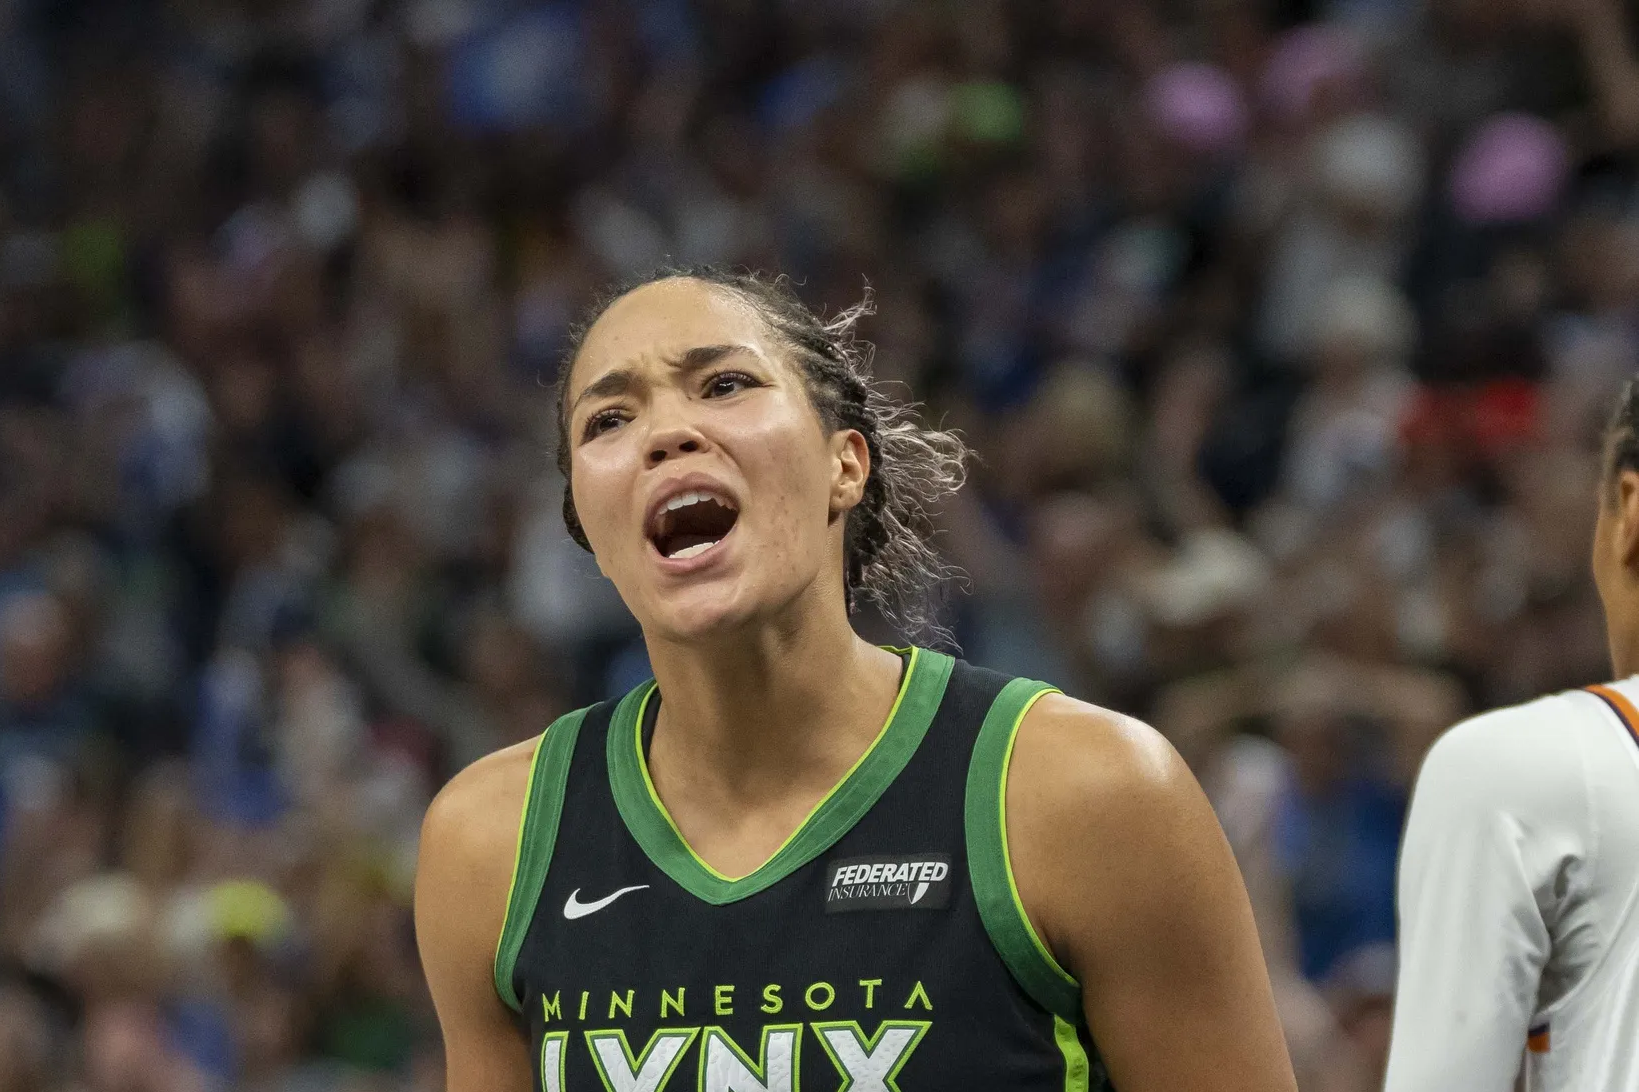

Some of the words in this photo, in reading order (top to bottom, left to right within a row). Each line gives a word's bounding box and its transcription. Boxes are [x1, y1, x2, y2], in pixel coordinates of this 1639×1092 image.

[832, 862, 949, 887] FEDERATED
[828, 882, 907, 902] INSURANCE
[542, 979, 933, 1022] MINNESOTA
